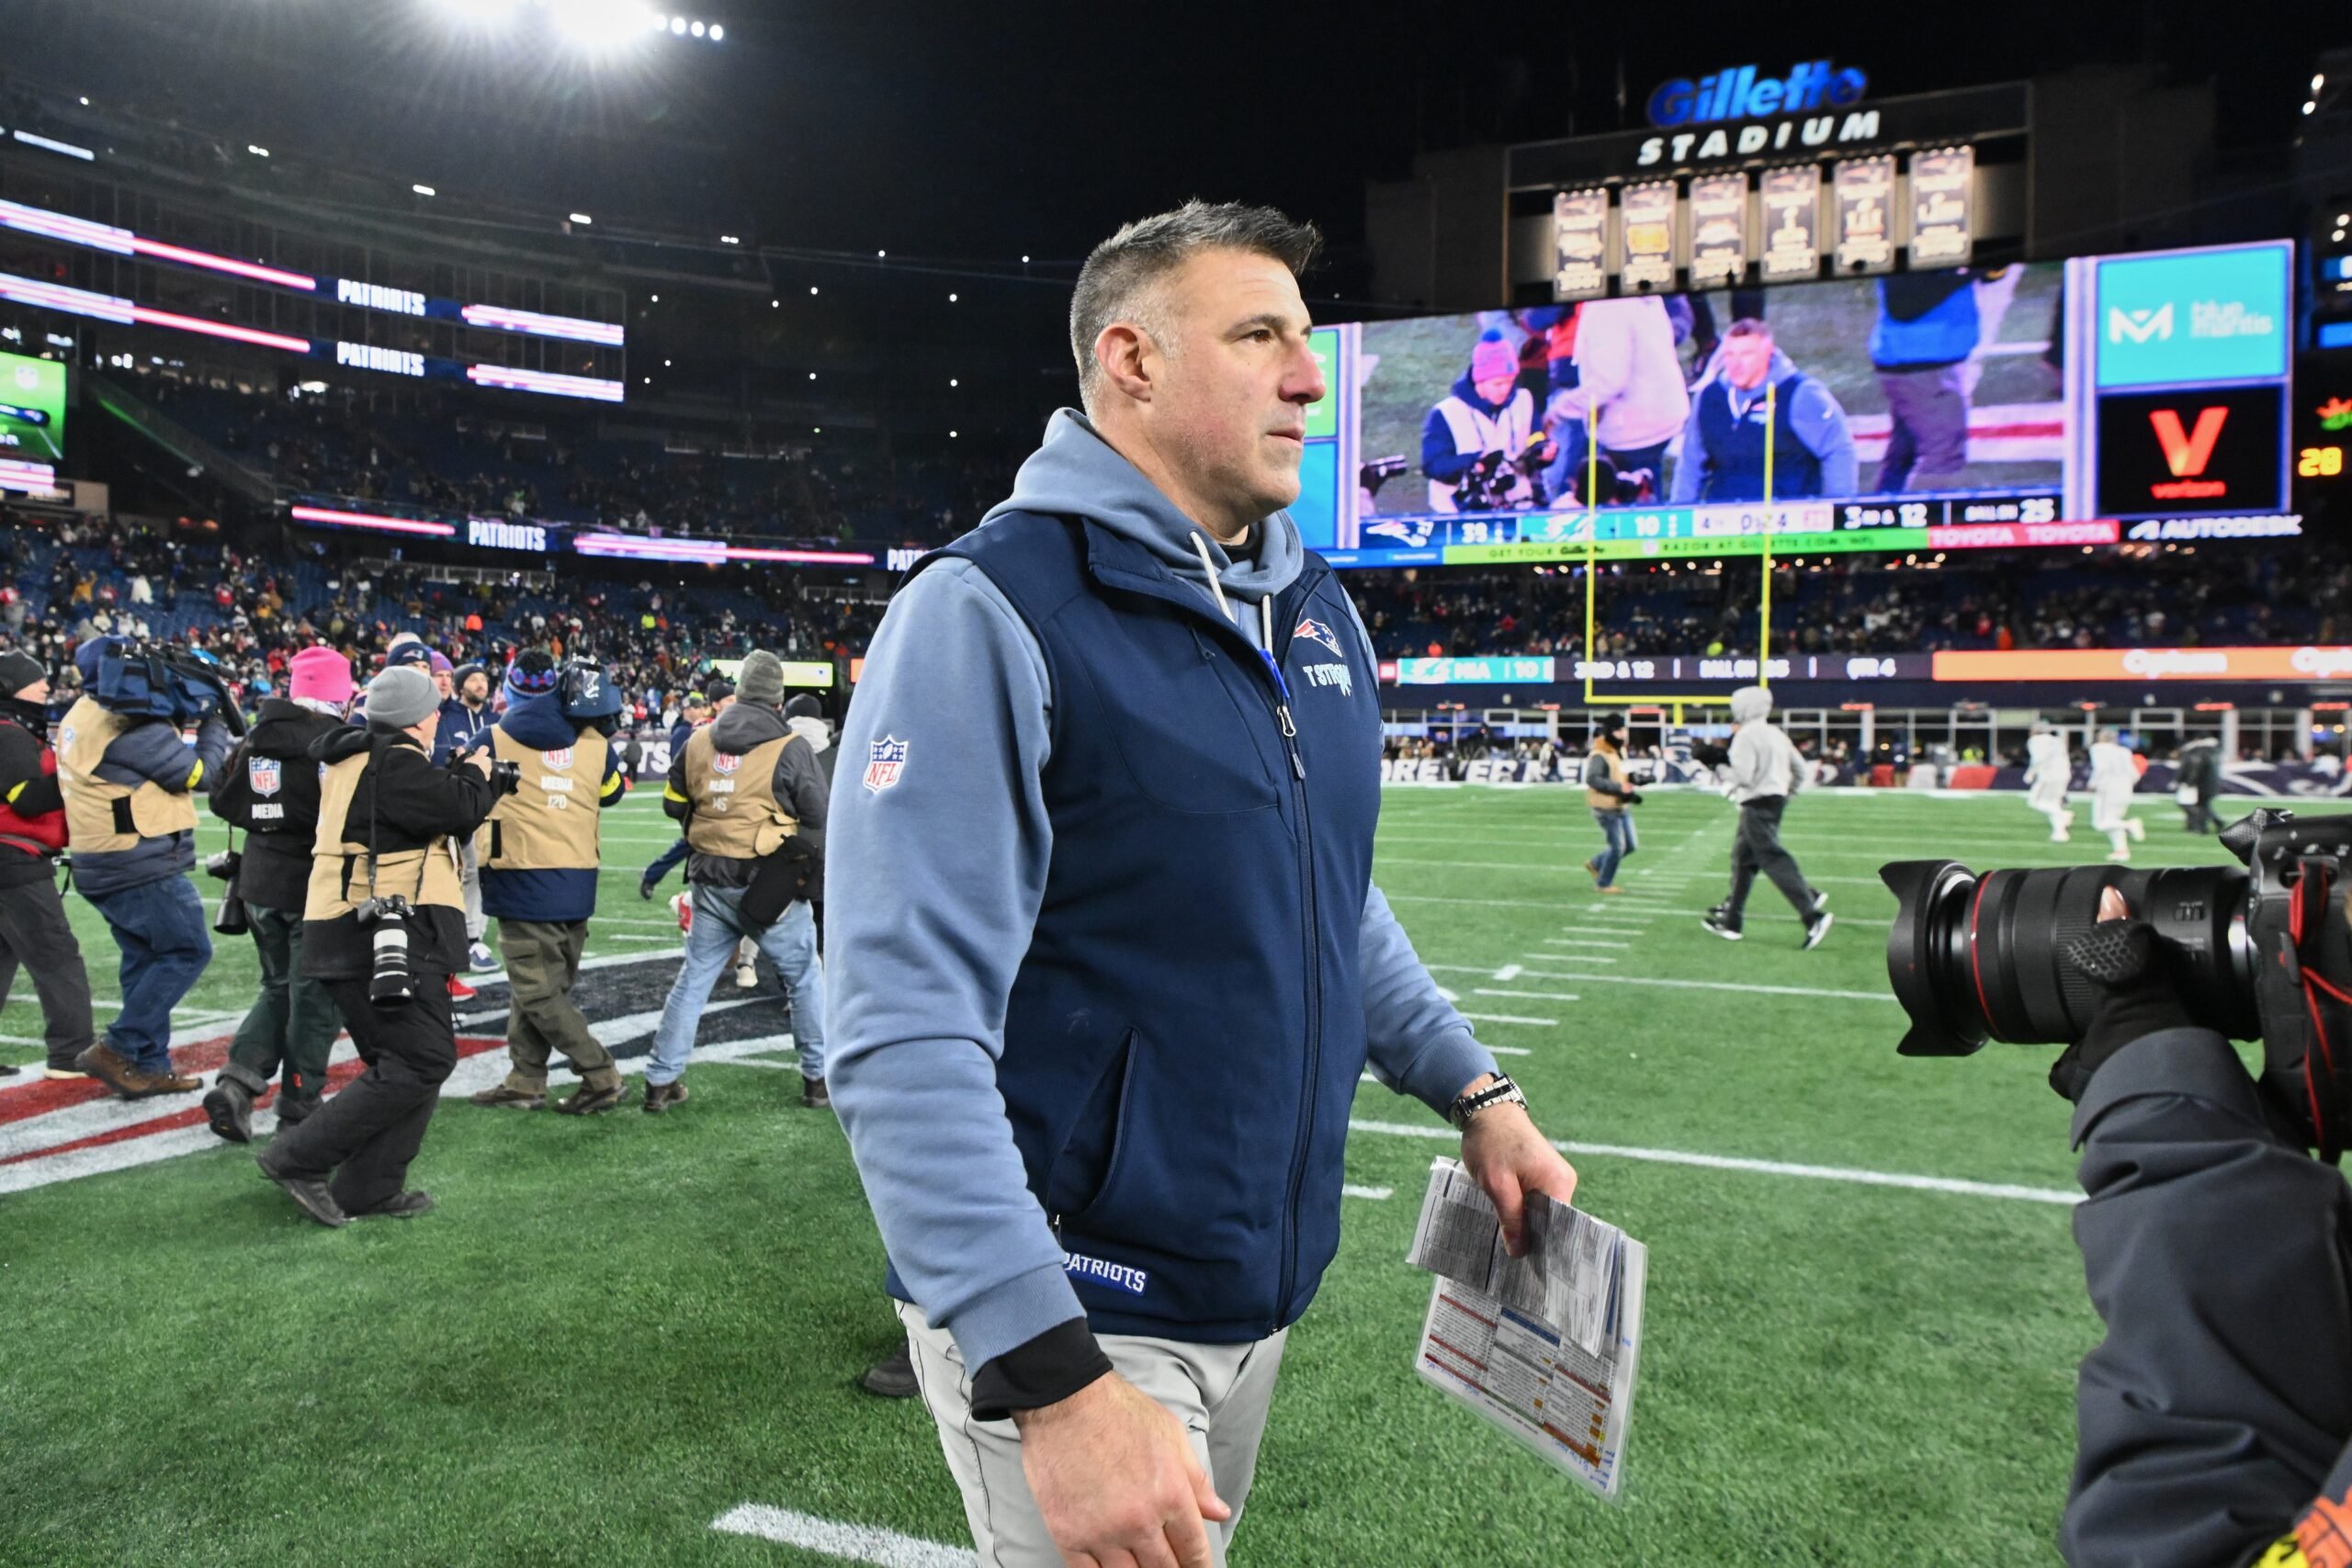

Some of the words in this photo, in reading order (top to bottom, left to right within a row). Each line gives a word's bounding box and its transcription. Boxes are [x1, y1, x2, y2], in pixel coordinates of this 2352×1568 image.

[1647, 59, 1869, 127] Gillette
[1636, 109, 1881, 165] STADIUM
[337, 278, 426, 317] PATRIOTS
[336, 341, 424, 377] PATRIOTS
[2298, 447, 2342, 477] 28
[1898, 503, 1928, 528] 12
[2019, 498, 2055, 524] 25
[469, 520, 546, 551] PATRIOTS
[1634, 515, 1660, 537] 10
[1932, 526, 2015, 546] TOYOTA
[2025, 523, 2116, 543] TOYOTA
[2160, 514, 2303, 539] AUTODESK
[1515, 661, 1539, 679] 10
[254, 773, 278, 790] NFL
[540, 776, 573, 792] MEDIA
[866, 762, 898, 786] NFL
[252, 803, 285, 819] MEDIA
